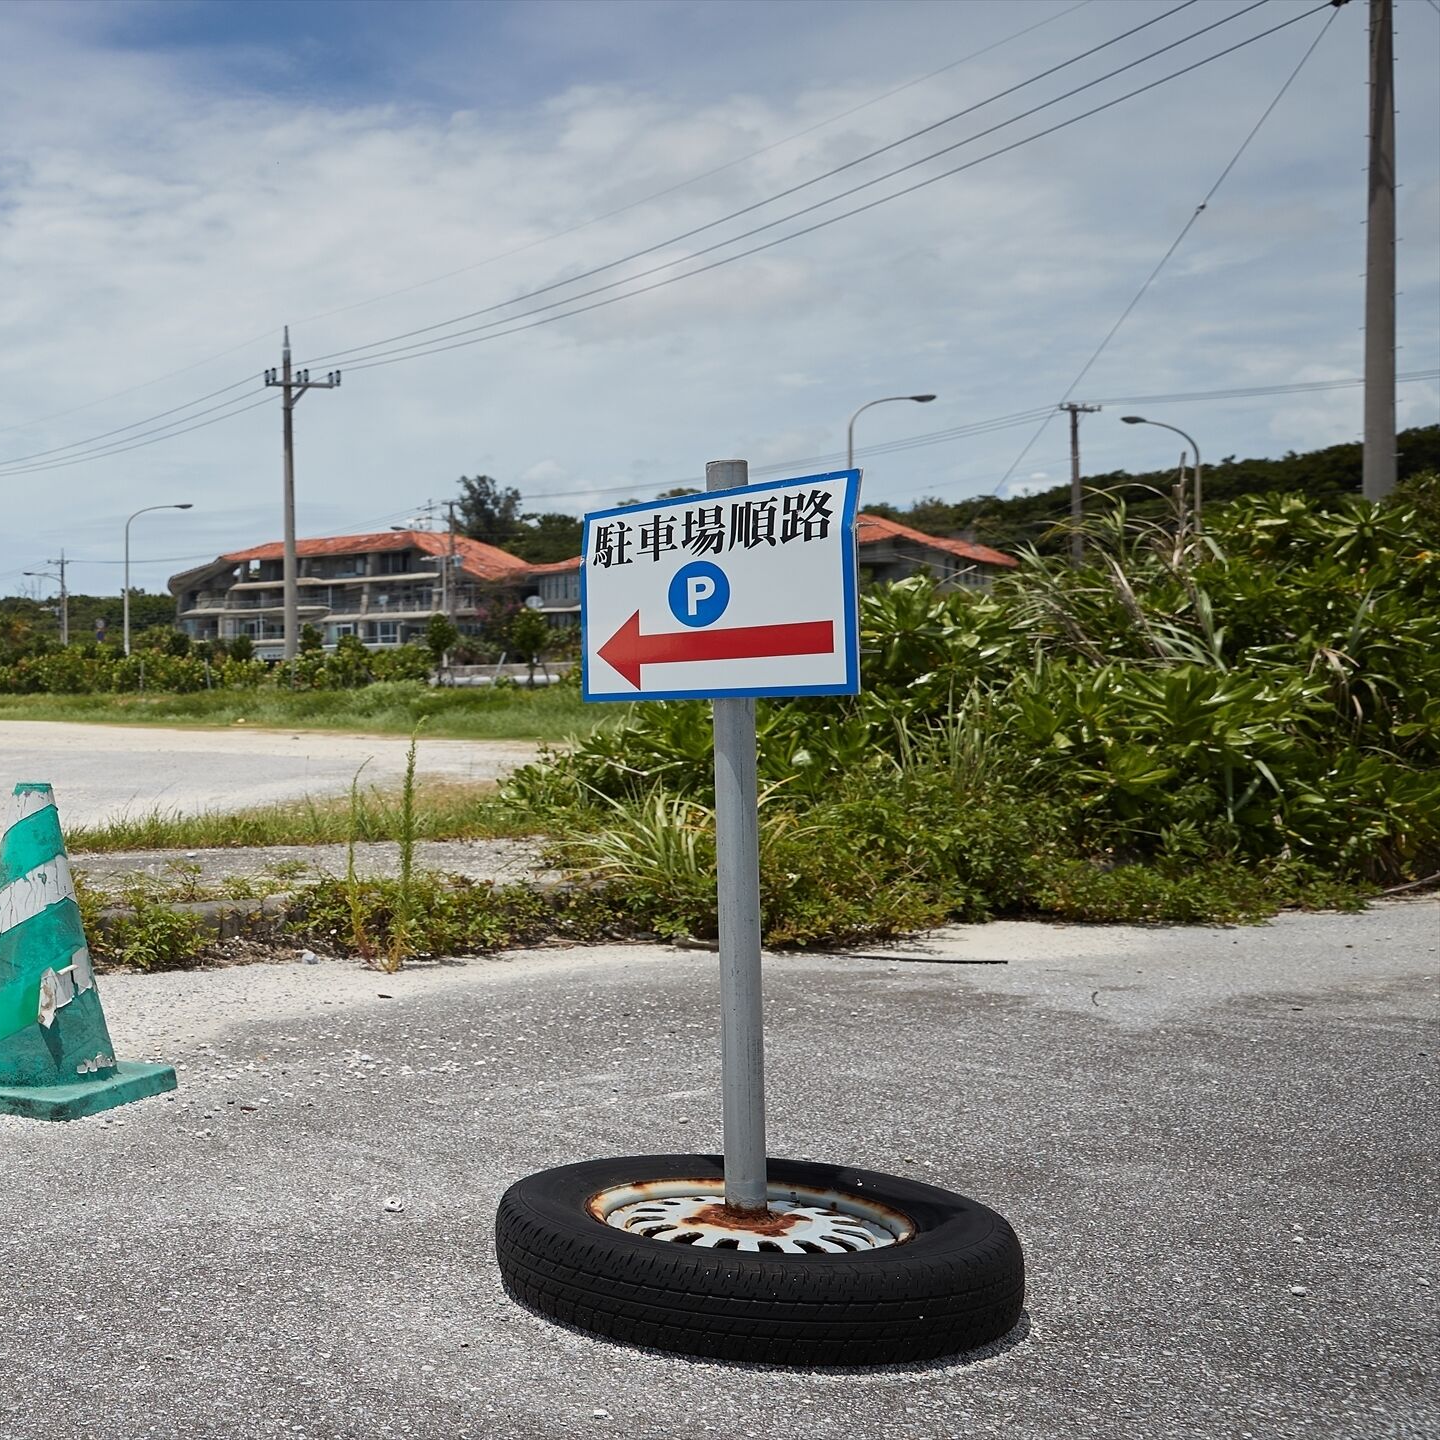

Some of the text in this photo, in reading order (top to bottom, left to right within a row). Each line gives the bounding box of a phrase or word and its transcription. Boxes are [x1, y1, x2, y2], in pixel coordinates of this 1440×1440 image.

[593, 489, 833, 568] 駐車場順路
[687, 576, 715, 616] P
